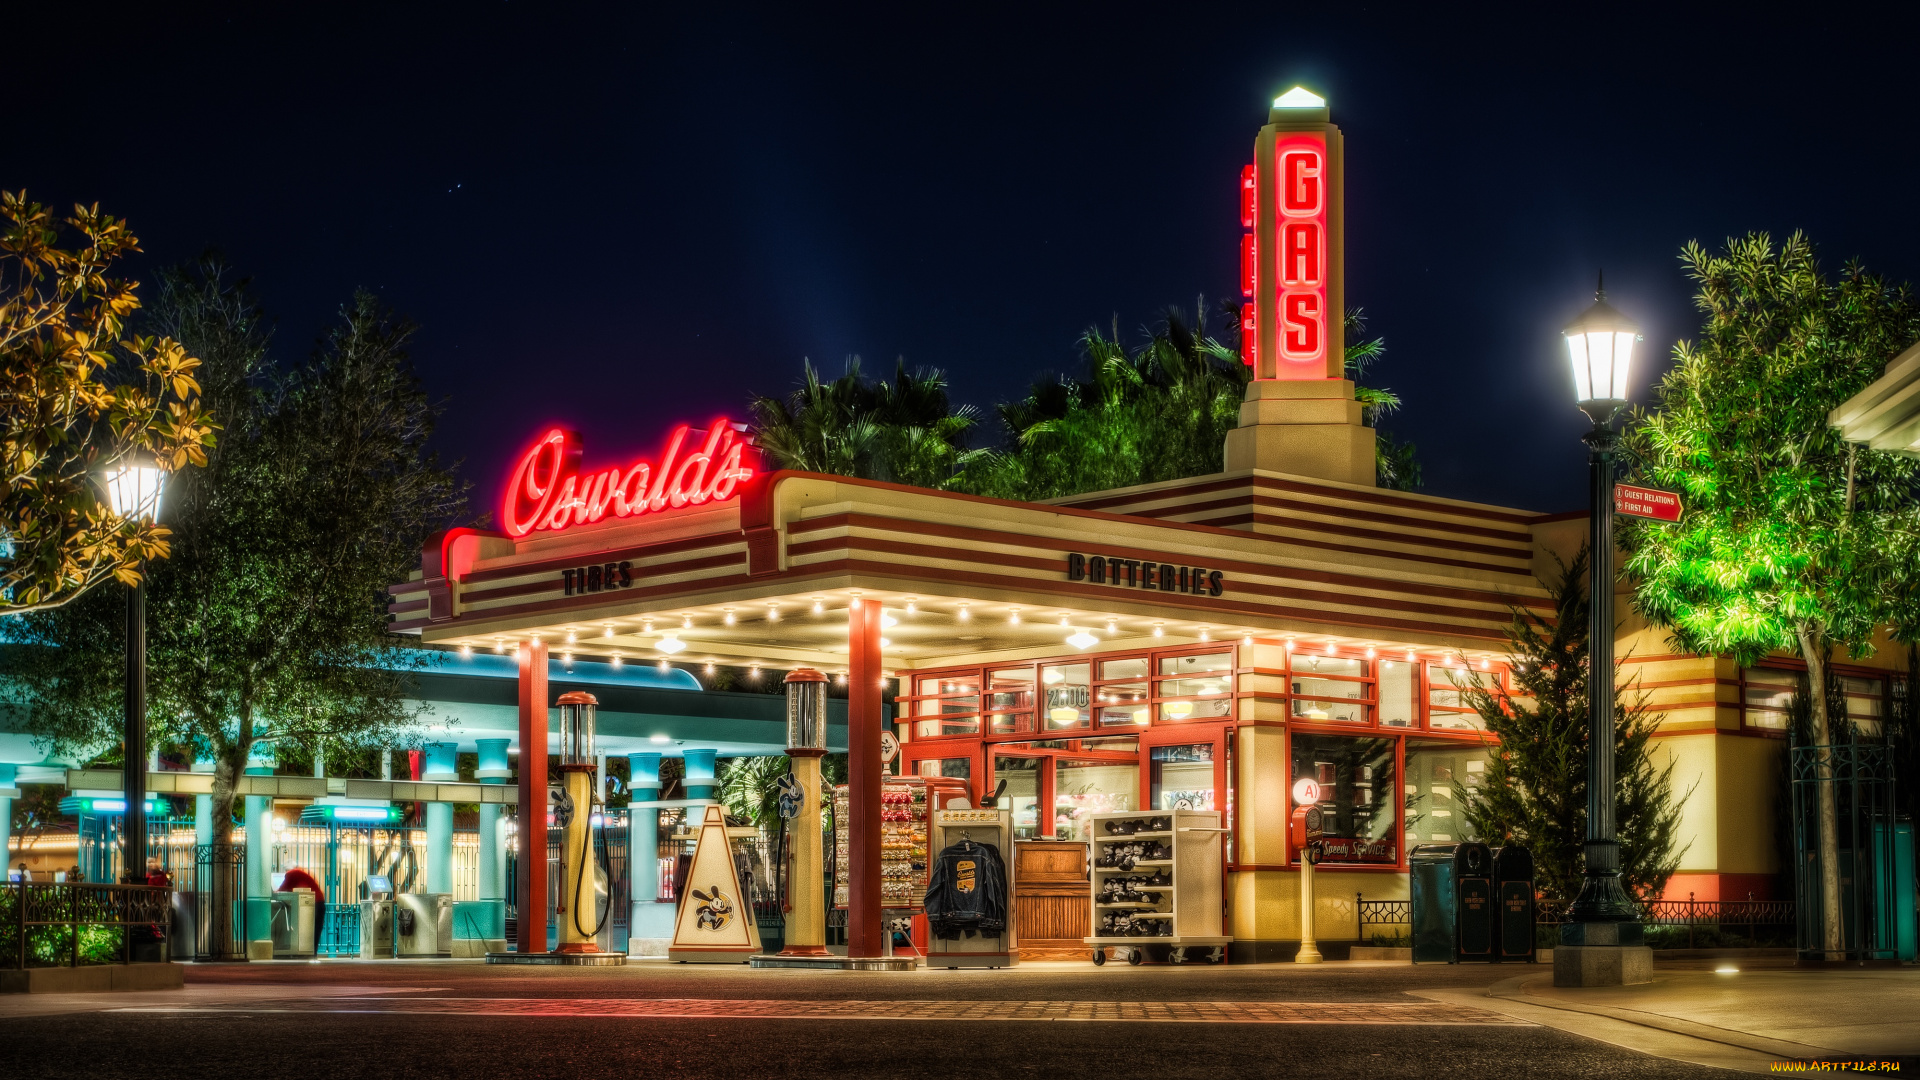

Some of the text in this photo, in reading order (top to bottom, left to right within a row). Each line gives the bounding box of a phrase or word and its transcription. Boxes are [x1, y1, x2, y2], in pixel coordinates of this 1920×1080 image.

[1282, 151, 1320, 356] GAS
[503, 418, 753, 537] Oswald's
[1624, 489, 1674, 505] GUEST RELATIONS
[1624, 502, 1653, 513] FIRST AID
[562, 561, 631, 596] TIRES
[1069, 552, 1224, 596] BATTERIES
[1324, 841, 1349, 858] Speedy
[1352, 842, 1386, 856] SERVICE
